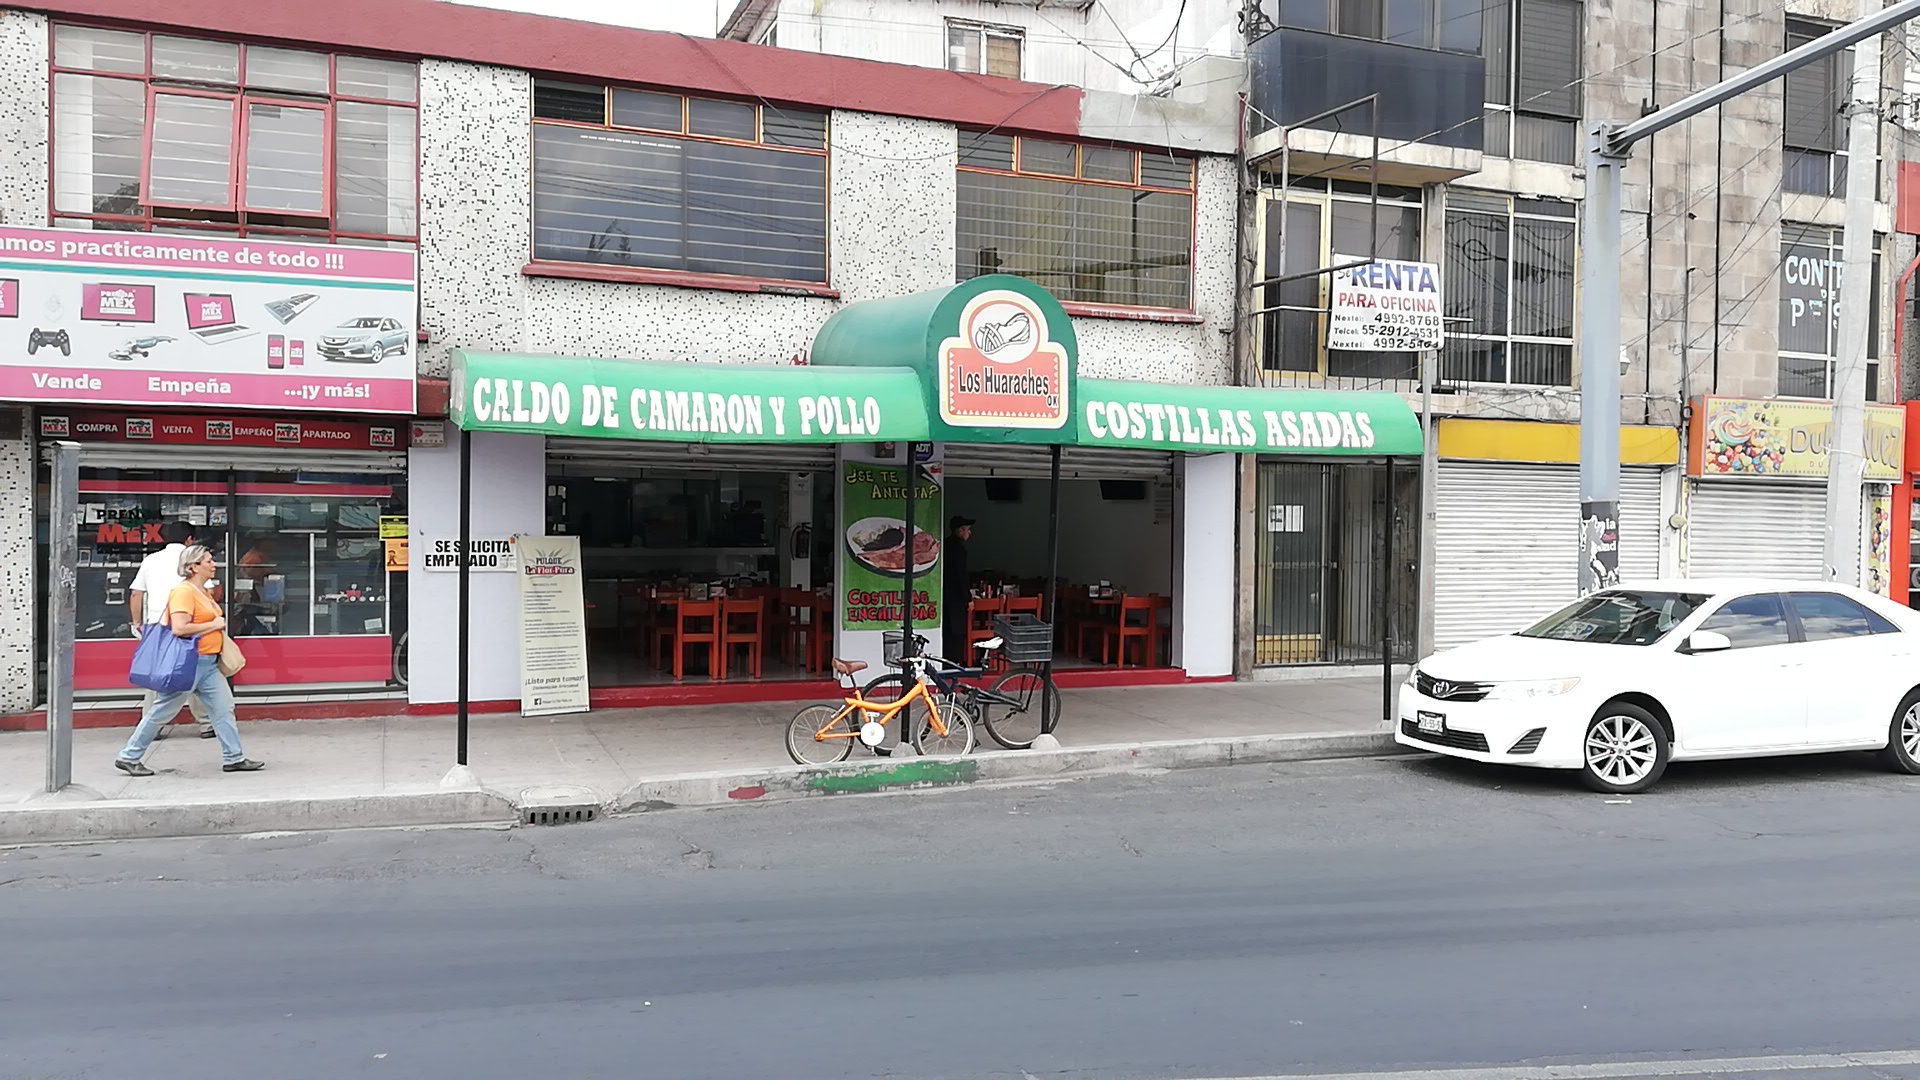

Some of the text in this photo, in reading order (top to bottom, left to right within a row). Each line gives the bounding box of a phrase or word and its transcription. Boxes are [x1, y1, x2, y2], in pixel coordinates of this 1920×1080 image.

[0, 236, 345, 270] mos practicamente de todo !!!
[1351, 262, 1437, 293] RENTA
[100, 297, 136, 309] MEX
[1339, 292, 1437, 313] PARA OFICINA
[1374, 313, 1439, 326] 4992-8768
[32, 373, 102, 390] Vende
[148, 377, 231, 396] Empeña
[324, 384, 370, 399] más!
[959, 366, 1049, 395] Los Huaraches
[473, 377, 881, 436] CALDO DE CAMARON Y POLLO
[76, 423, 118, 433] COMPRA
[162, 425, 194, 434] VENTA
[235, 426, 273, 437] EMPEÑO
[303, 430, 351, 440] APARTADO
[1086, 400, 1376, 448] COSTILLAS ASADAS
[915, 443, 931, 453] ADT
[846, 468, 898, 484] ¿SE TE
[96, 523, 165, 544] MEX
[435, 540, 511, 553] SE SLICITA
[425, 554, 498, 567] EMPLADO
[536, 557, 562, 565] PULQUE
[525, 566, 536, 575] La
[847, 588, 929, 606] COSTILAS
